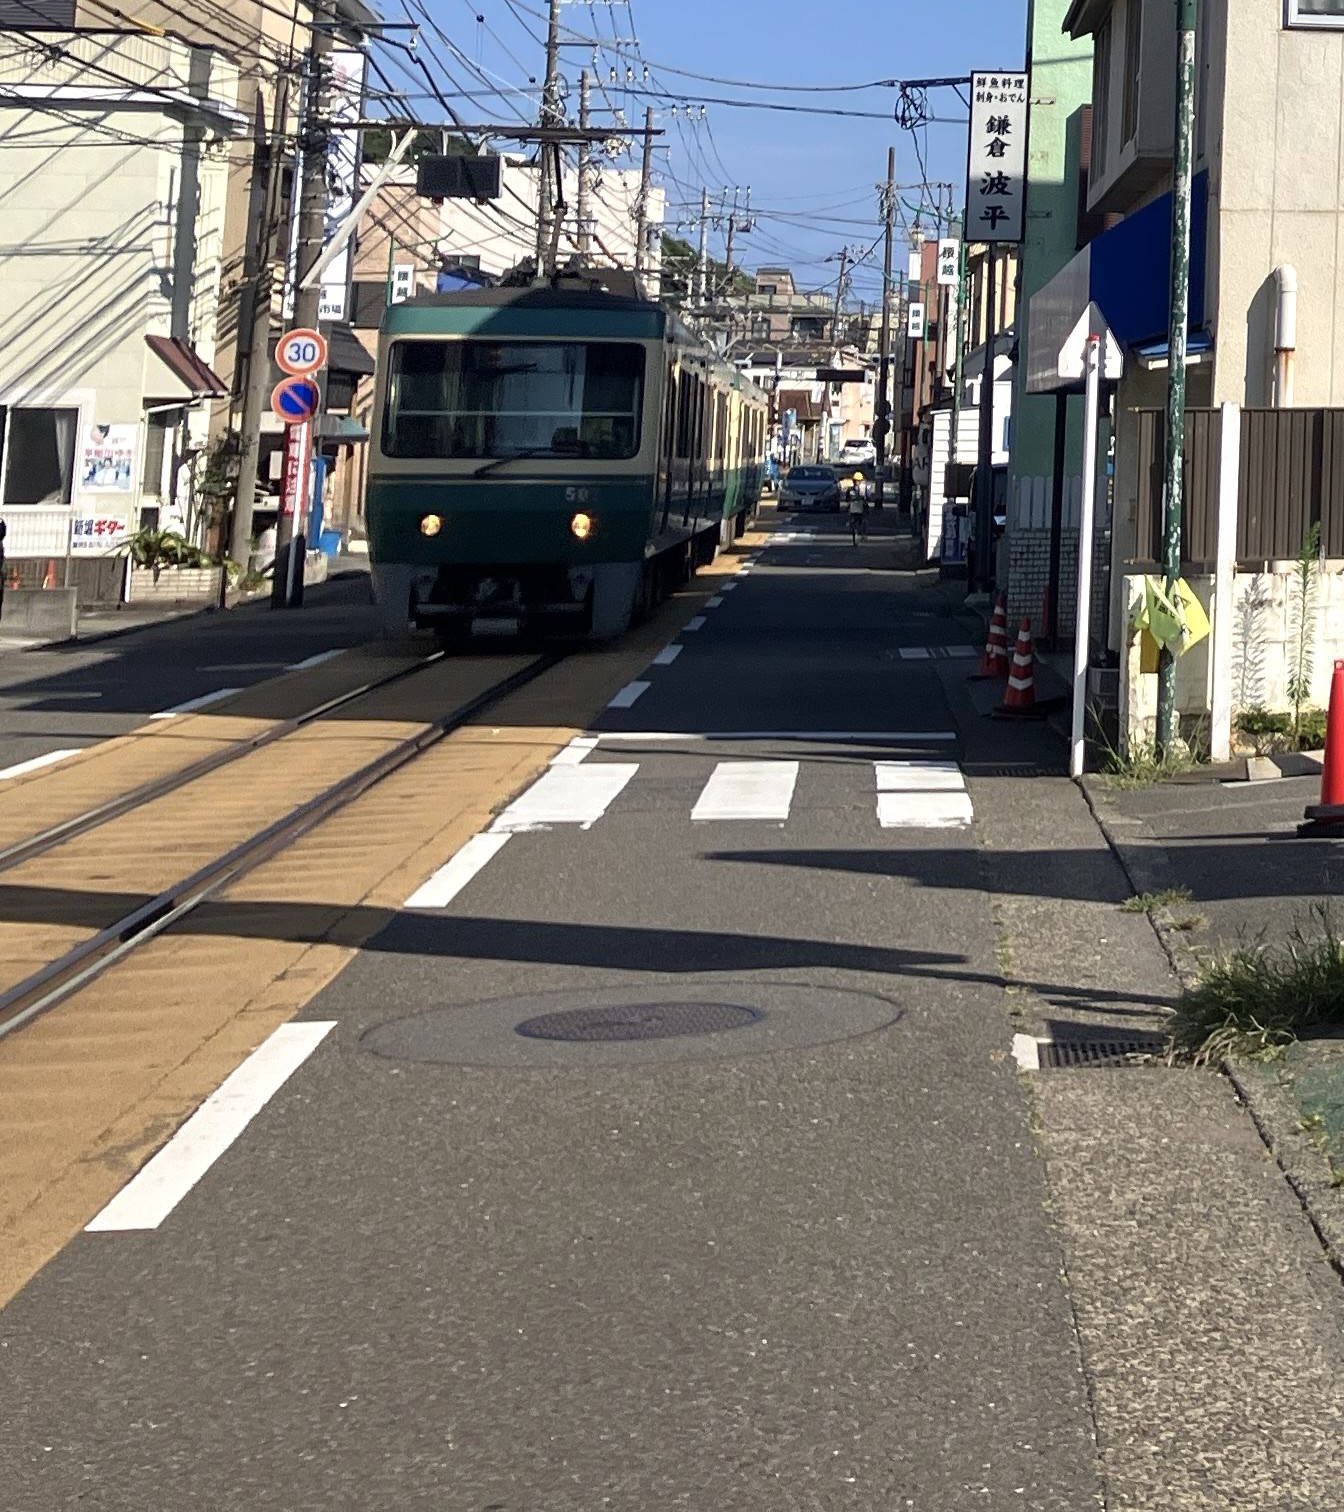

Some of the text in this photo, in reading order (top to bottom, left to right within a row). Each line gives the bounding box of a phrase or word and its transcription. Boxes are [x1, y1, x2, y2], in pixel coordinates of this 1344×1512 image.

[976, 77, 1025, 89] 鮮魚料理
[288, 343, 315, 363] 30
